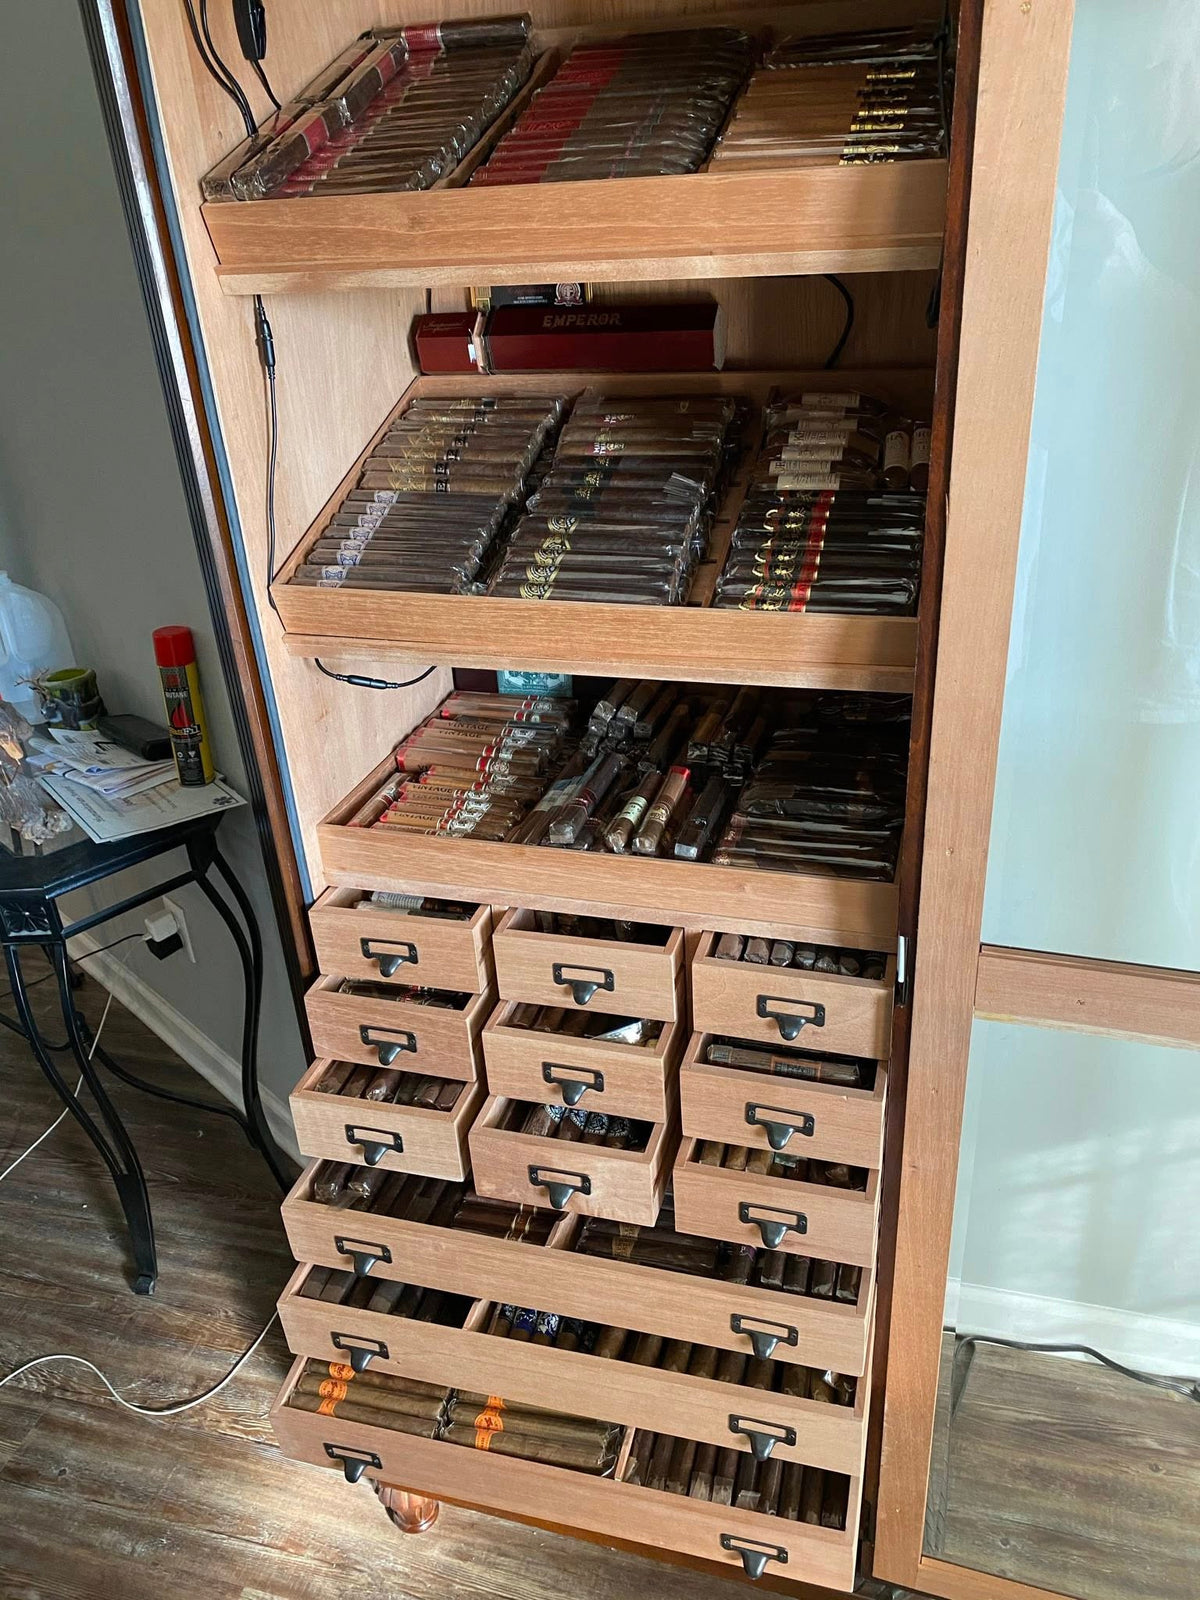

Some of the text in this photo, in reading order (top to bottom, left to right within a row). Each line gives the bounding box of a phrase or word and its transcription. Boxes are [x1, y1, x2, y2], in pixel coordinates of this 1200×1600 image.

[542, 312, 623, 328] EMPEROR
[448, 722, 489, 731] VINTAGE
[412, 783, 453, 795] VINTAGE
